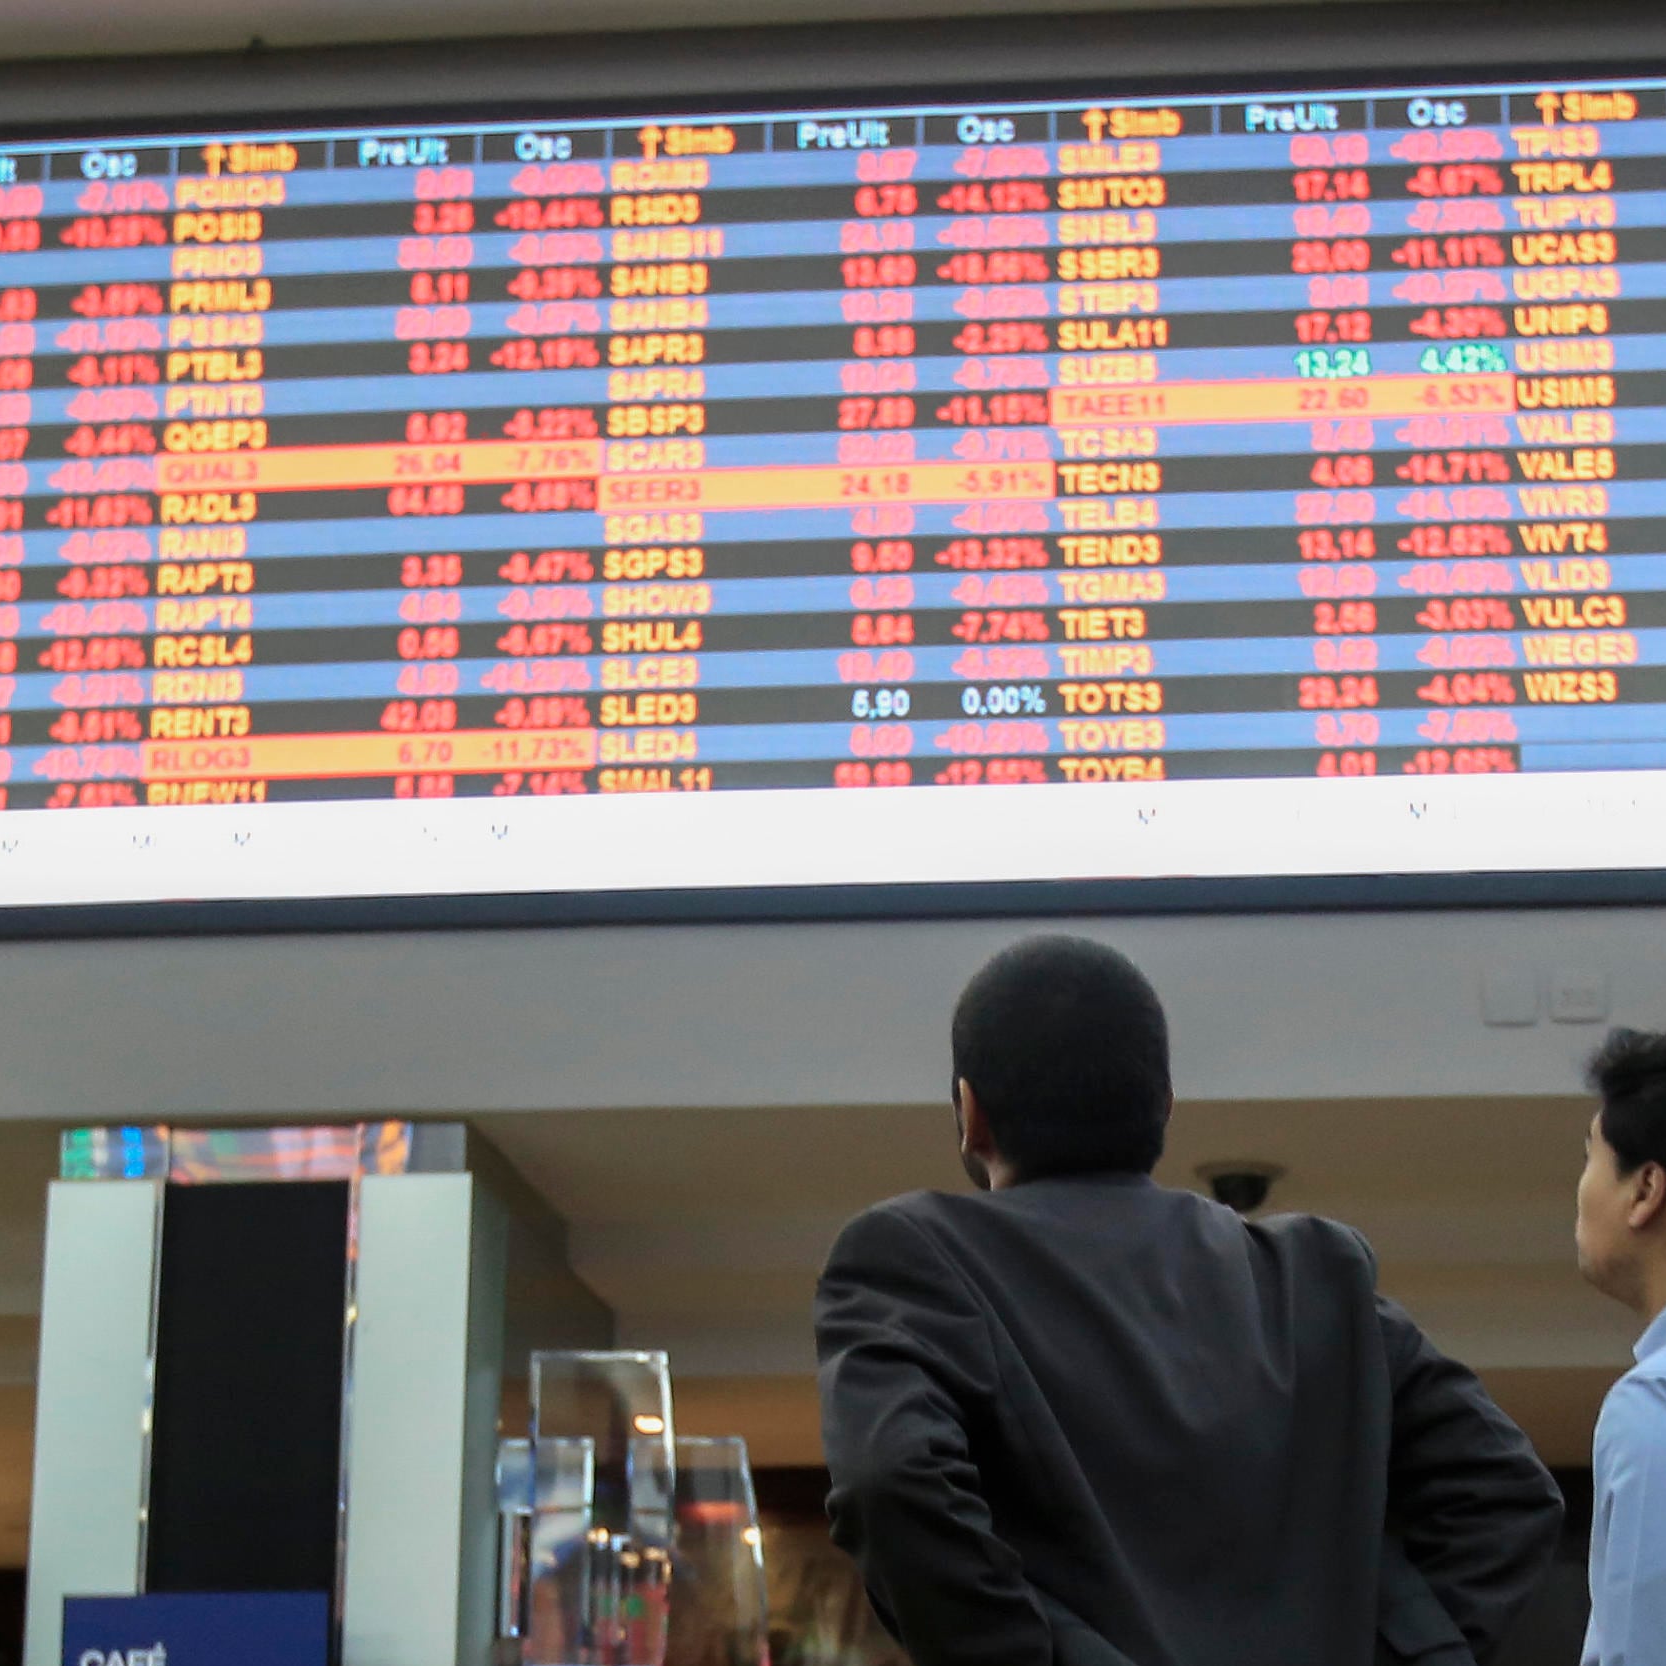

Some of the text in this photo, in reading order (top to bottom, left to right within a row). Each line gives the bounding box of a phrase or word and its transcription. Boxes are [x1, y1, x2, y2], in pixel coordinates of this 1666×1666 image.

[1108, 100, 1467, 137] Simb PreUlt Osc
[1563, 93, 1637, 120] Simb
[665, 116, 1015, 154] Simb PreUlt Osc
[228, 134, 571, 173] Simb PreUlt Osc
[1512, 233, 1617, 264] UCAS3
[1294, 349, 1371, 378] 13,24
[1421, 344, 1507, 374] 4,42%
[1065, 394, 1166, 417] TAEE11
[841, 473, 911, 497] 24,18
[957, 470, 1046, 492] -5,91%
[603, 549, 704, 580] SGPS3
[1058, 535, 1162, 566] TEND3
[1058, 608, 1146, 639] TIET3
[1520, 596, 1626, 628] VULC3
[962, 686, 1046, 716] 0,00%
[1058, 682, 1163, 714] TOTS3
